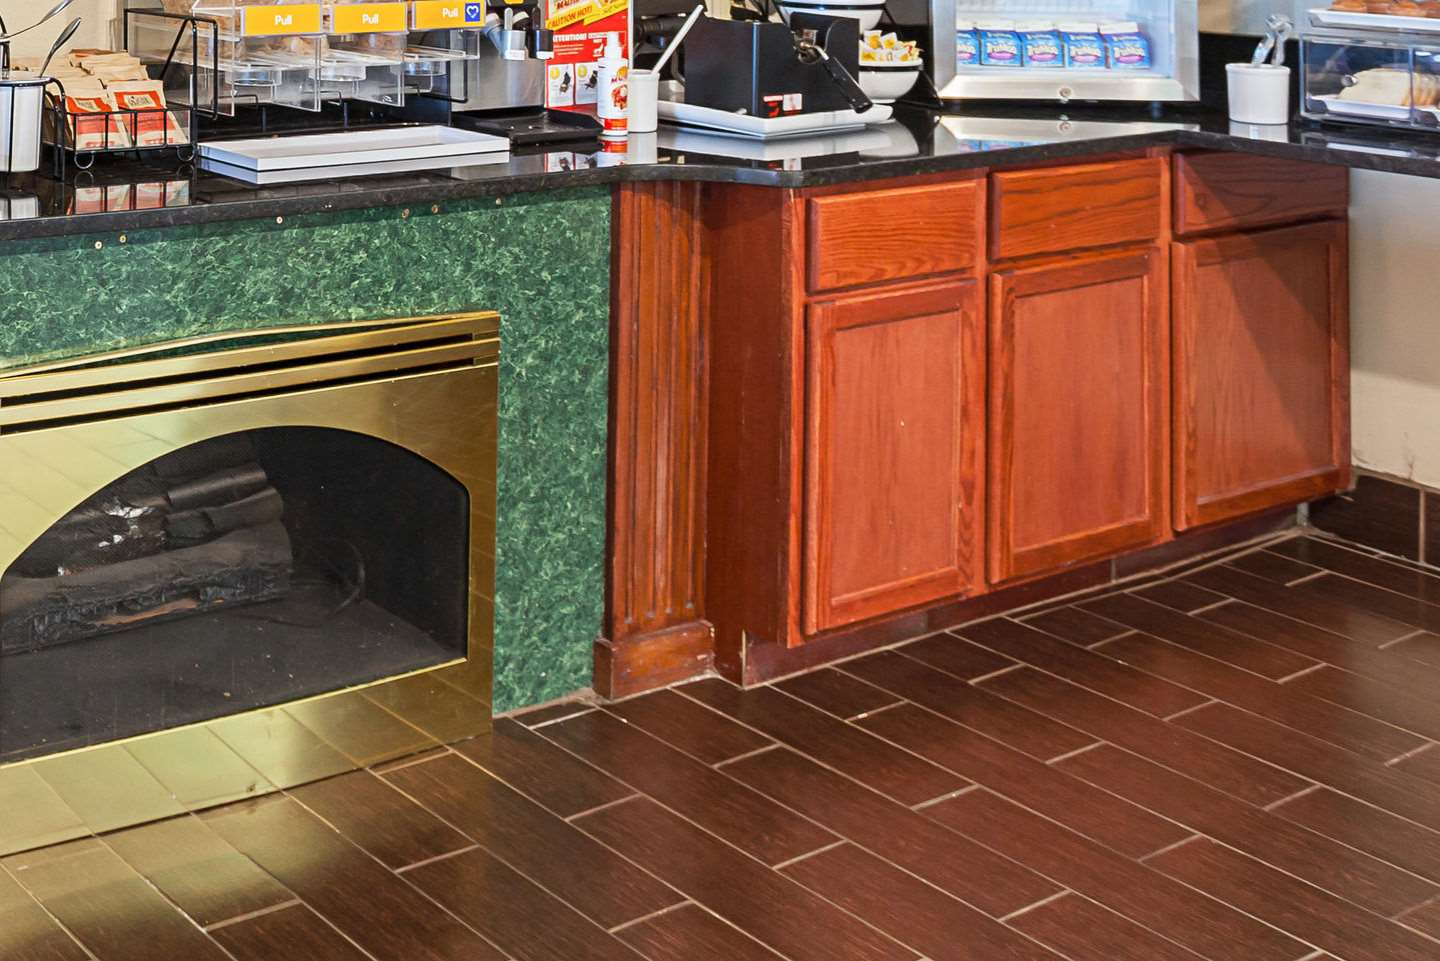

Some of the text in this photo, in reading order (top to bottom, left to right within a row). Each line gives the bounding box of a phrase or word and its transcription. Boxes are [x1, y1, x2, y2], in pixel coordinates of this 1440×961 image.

[442, 7, 459, 18] Pull
[274, 14, 293, 26] Pull
[362, 13, 379, 25] Pull
[553, 33, 587, 42] TTENTION!
